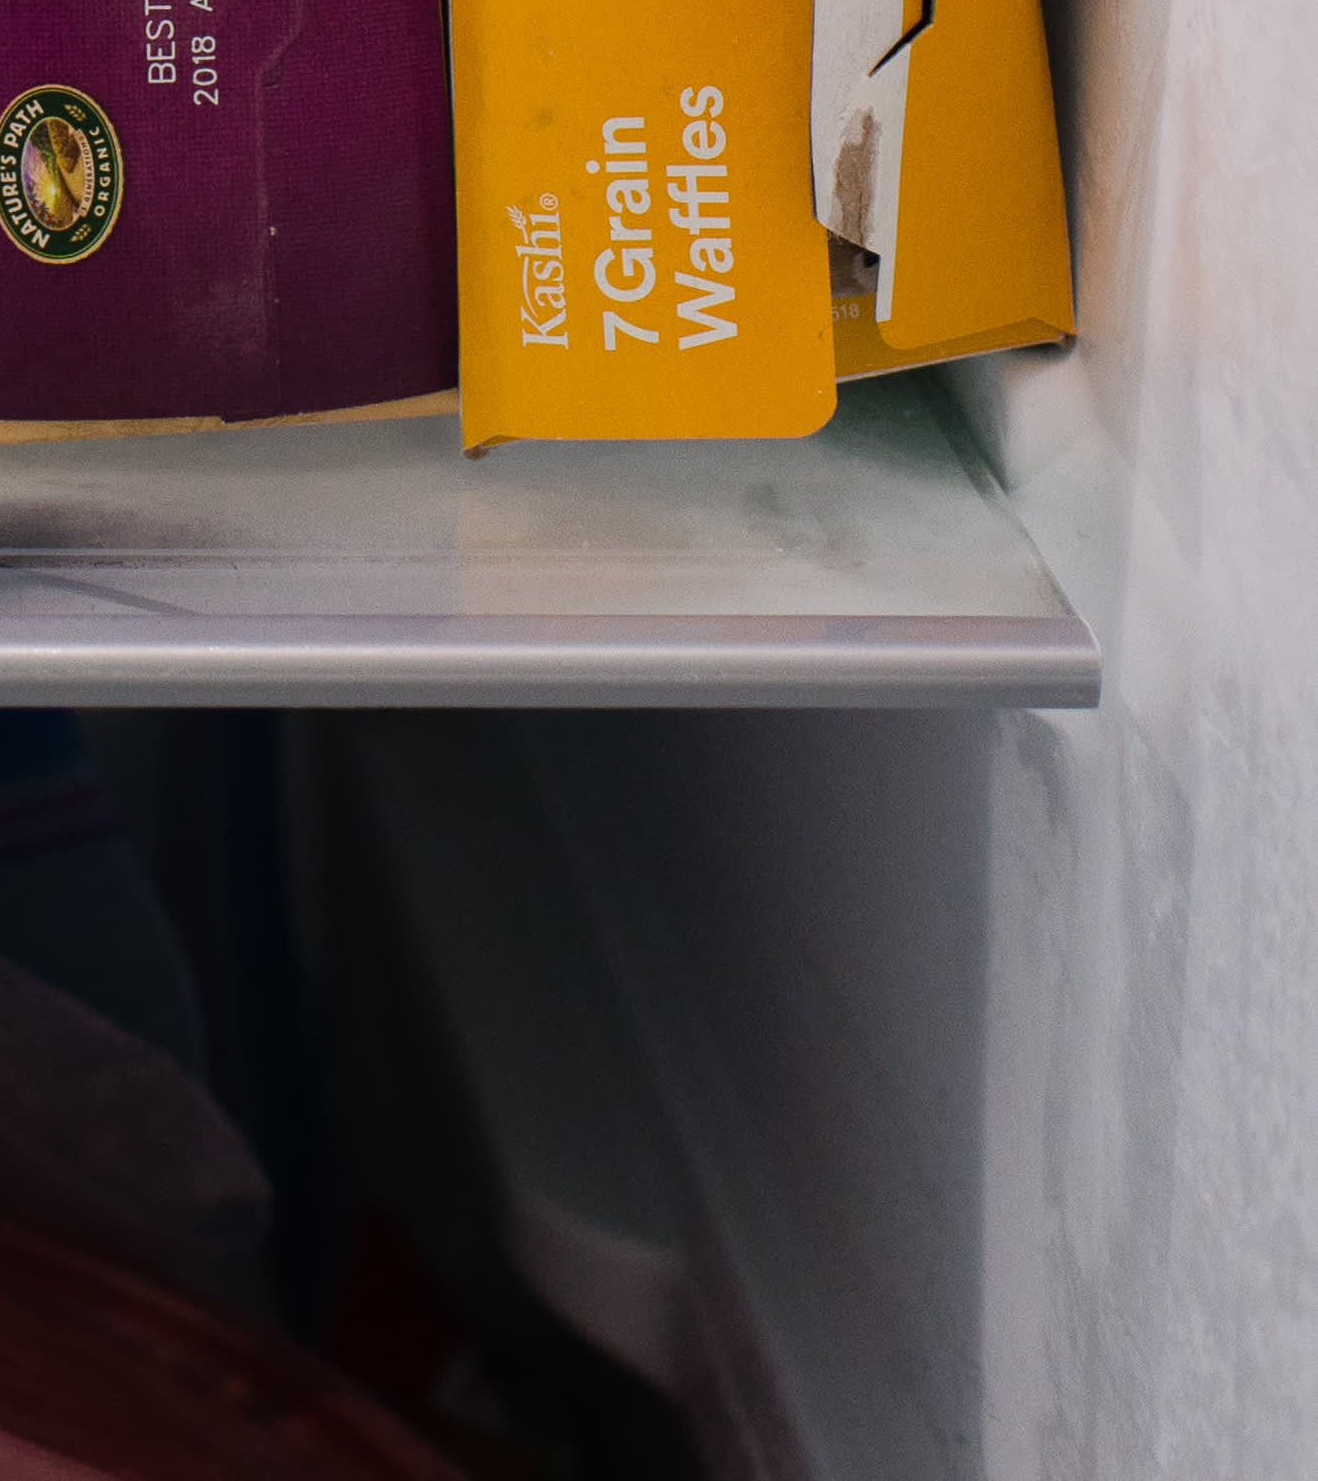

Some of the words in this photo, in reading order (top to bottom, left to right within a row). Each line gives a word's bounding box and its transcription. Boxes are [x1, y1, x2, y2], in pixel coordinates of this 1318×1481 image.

[192, 35, 219, 107] 2018
[4, 98, 45, 149] PATH
[90, 124, 111, 218] ORGANIC
[1, 153, 51, 250] NATURE'S
[585, 114, 661, 303] Grain
[665, 84, 739, 351] Waffles
[512, 206, 569, 350] Kashi
[601, 311, 661, 352] 7
